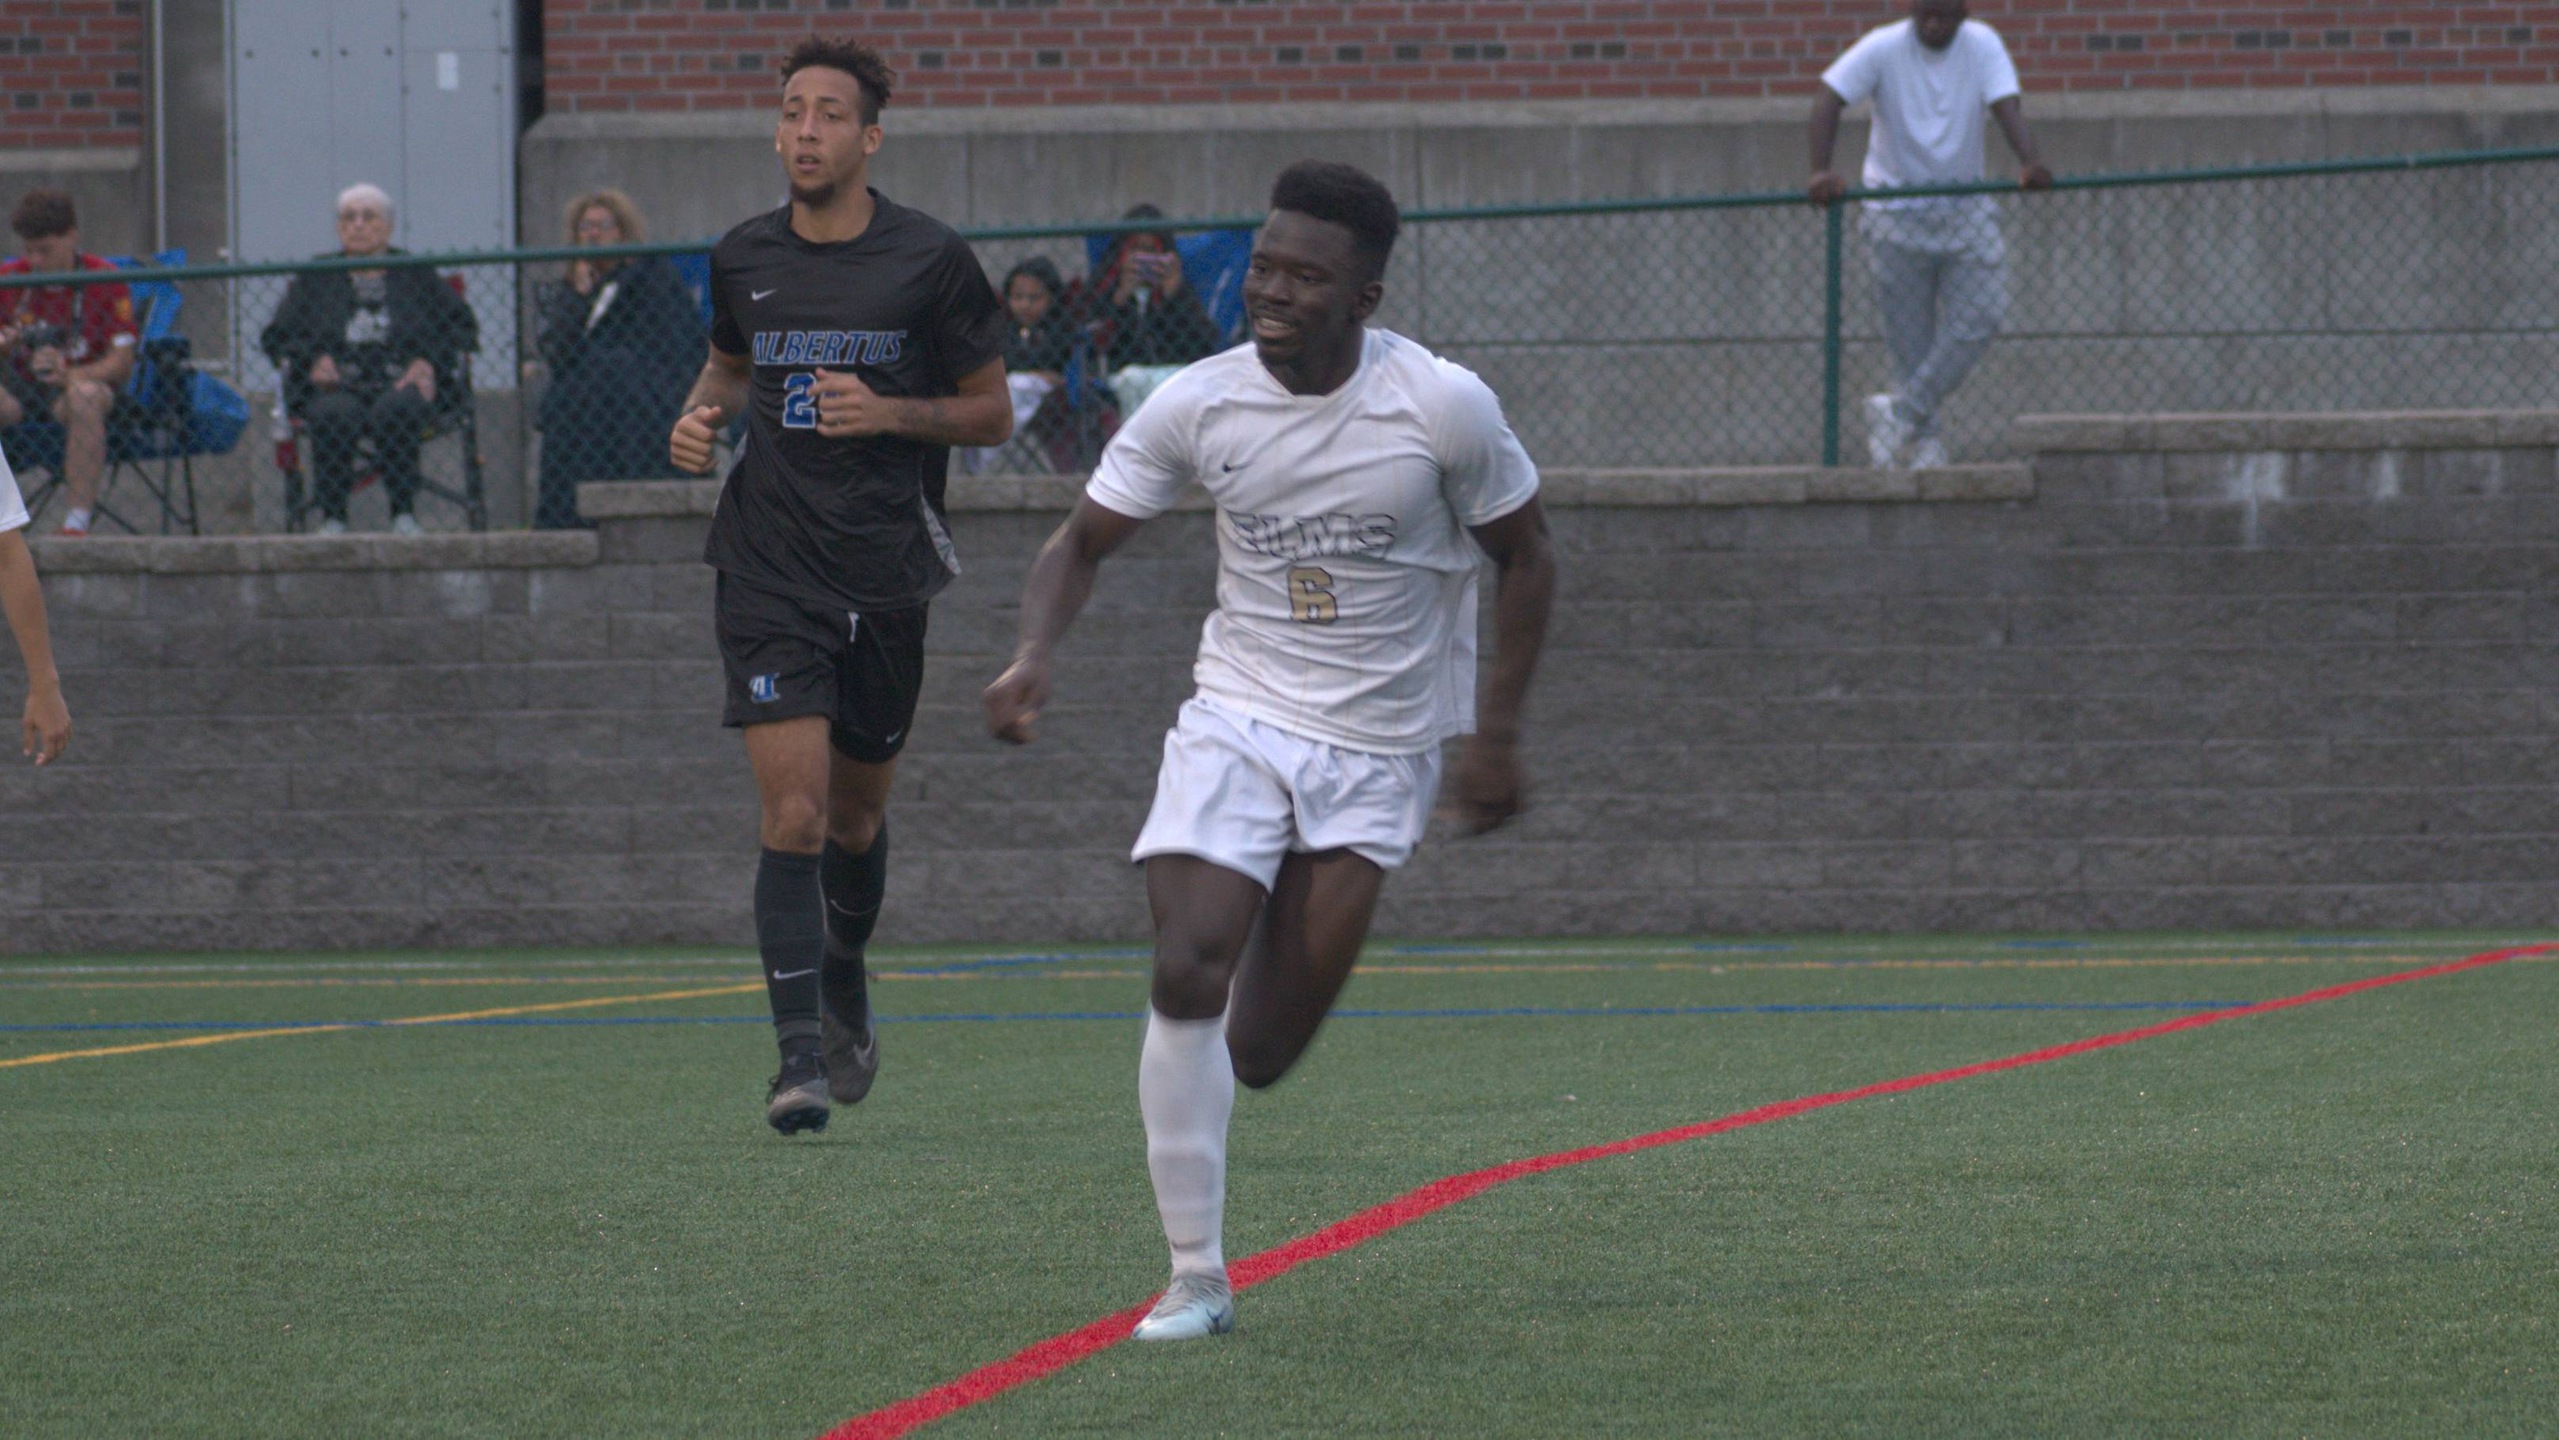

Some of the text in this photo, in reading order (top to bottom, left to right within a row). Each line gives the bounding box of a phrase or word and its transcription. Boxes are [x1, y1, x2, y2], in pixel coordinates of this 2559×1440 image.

[752, 329, 908, 366] ALBERTUS
[783, 372, 840, 429] 2
[1287, 564, 1339, 625] 6
